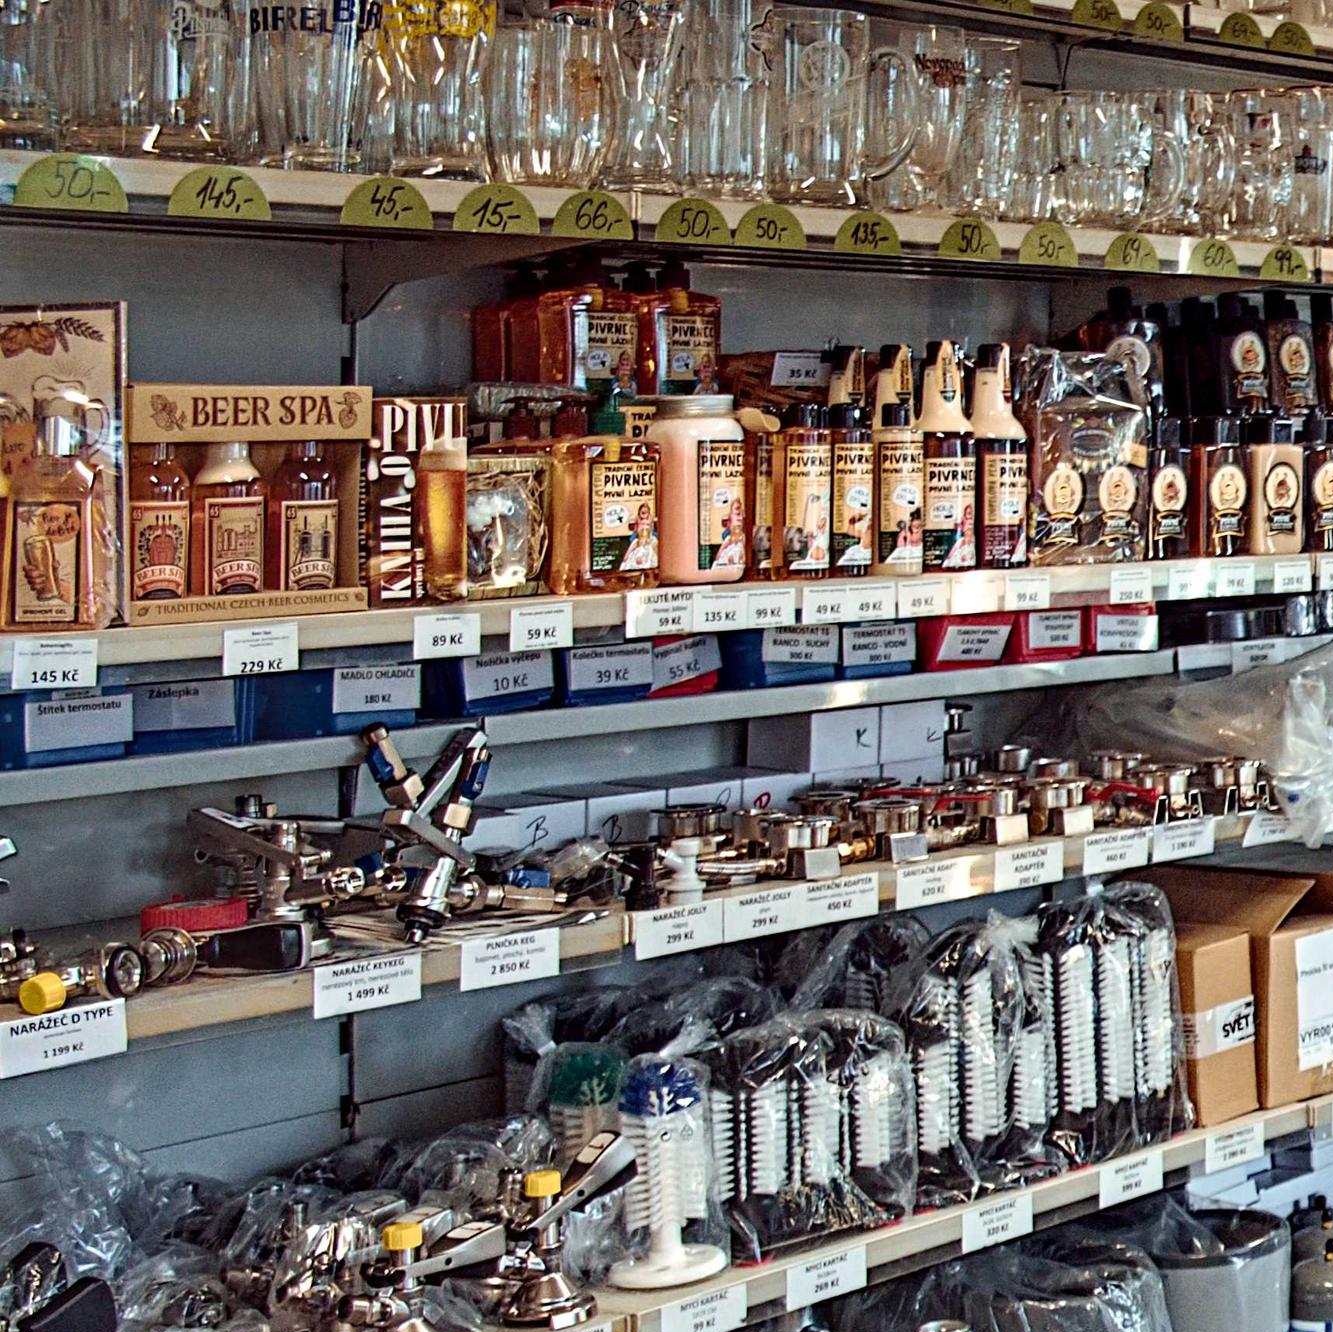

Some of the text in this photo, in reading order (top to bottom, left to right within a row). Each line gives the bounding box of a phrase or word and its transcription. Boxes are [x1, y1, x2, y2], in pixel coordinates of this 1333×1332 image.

[191, 394, 335, 428] BEER SPA
[604, 473, 654, 487] PIVRNEC
[380, 492, 412, 600] KNIHA
[157, 594, 350, 615] TRADITIONAL CZECH BEER COSMETICS
[755, 606, 782, 618] 99 Kč
[816, 602, 842, 614] 49 Kč
[859, 600, 883, 612] 49 Kč
[705, 610, 736, 623] 135 Kč
[432, 631, 464, 647] 89 Kč
[527, 625, 557, 640] 59 Kč
[572, 650, 603, 661] Kolečko
[241, 656, 283, 673] 229 Kč
[31, 667, 79, 684] 145 Kč
[341, 667, 416, 681] MADLO CHLADIČE
[595, 668, 630, 683] 39 Kč
[494, 674, 529, 691] 10 Kč
[148, 686, 200, 699] Záslepka
[37, 700, 122, 716] Štítek termostatu
[331, 956, 406, 978] NARÁŽEČ KEYKEG
[9, 1006, 114, 1037] NARÁŽEČ D TYPE
[1223, 1013, 1250, 1038] SVĚT
